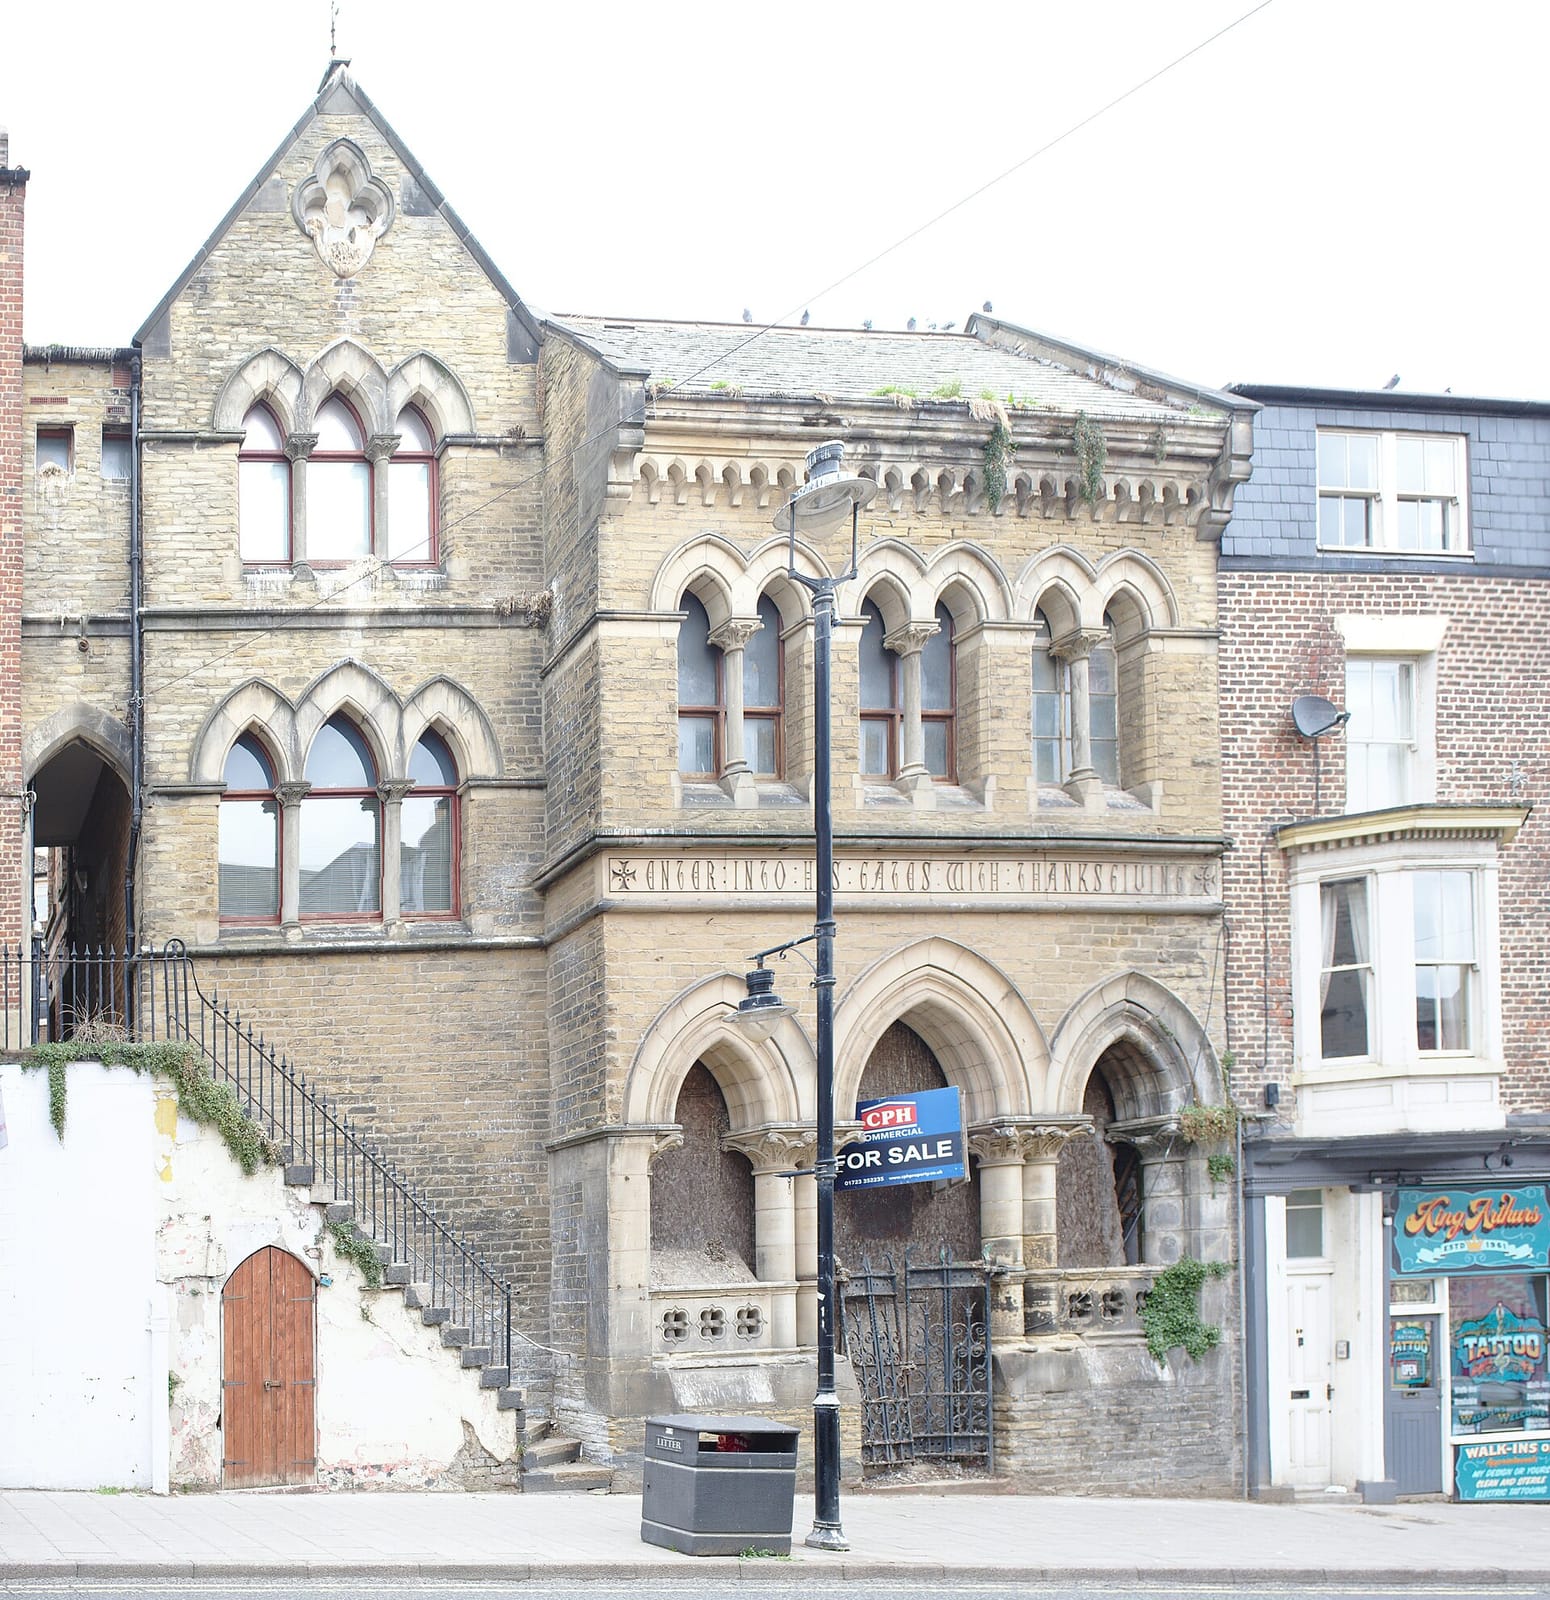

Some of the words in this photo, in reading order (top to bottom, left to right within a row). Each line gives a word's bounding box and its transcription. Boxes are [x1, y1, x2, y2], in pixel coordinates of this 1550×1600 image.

[803, 861, 841, 891] HS
[866, 1107, 912, 1127] CPH
[864, 1127, 924, 1143] OMMERCIAL
[835, 1150, 882, 1171] FOR
[888, 1140, 953, 1164] SALE
[1404, 1195, 1466, 1242] King
[1463, 1192, 1543, 1234] Arthurs
[1443, 1242, 1466, 1252] ESTD
[1389, 1341, 1429, 1354] TATTOO
[1462, 1334, 1541, 1364] TATTOO
[656, 1437, 681, 1450] LITTER
[1465, 1442, 1538, 1459] WALK-INS
